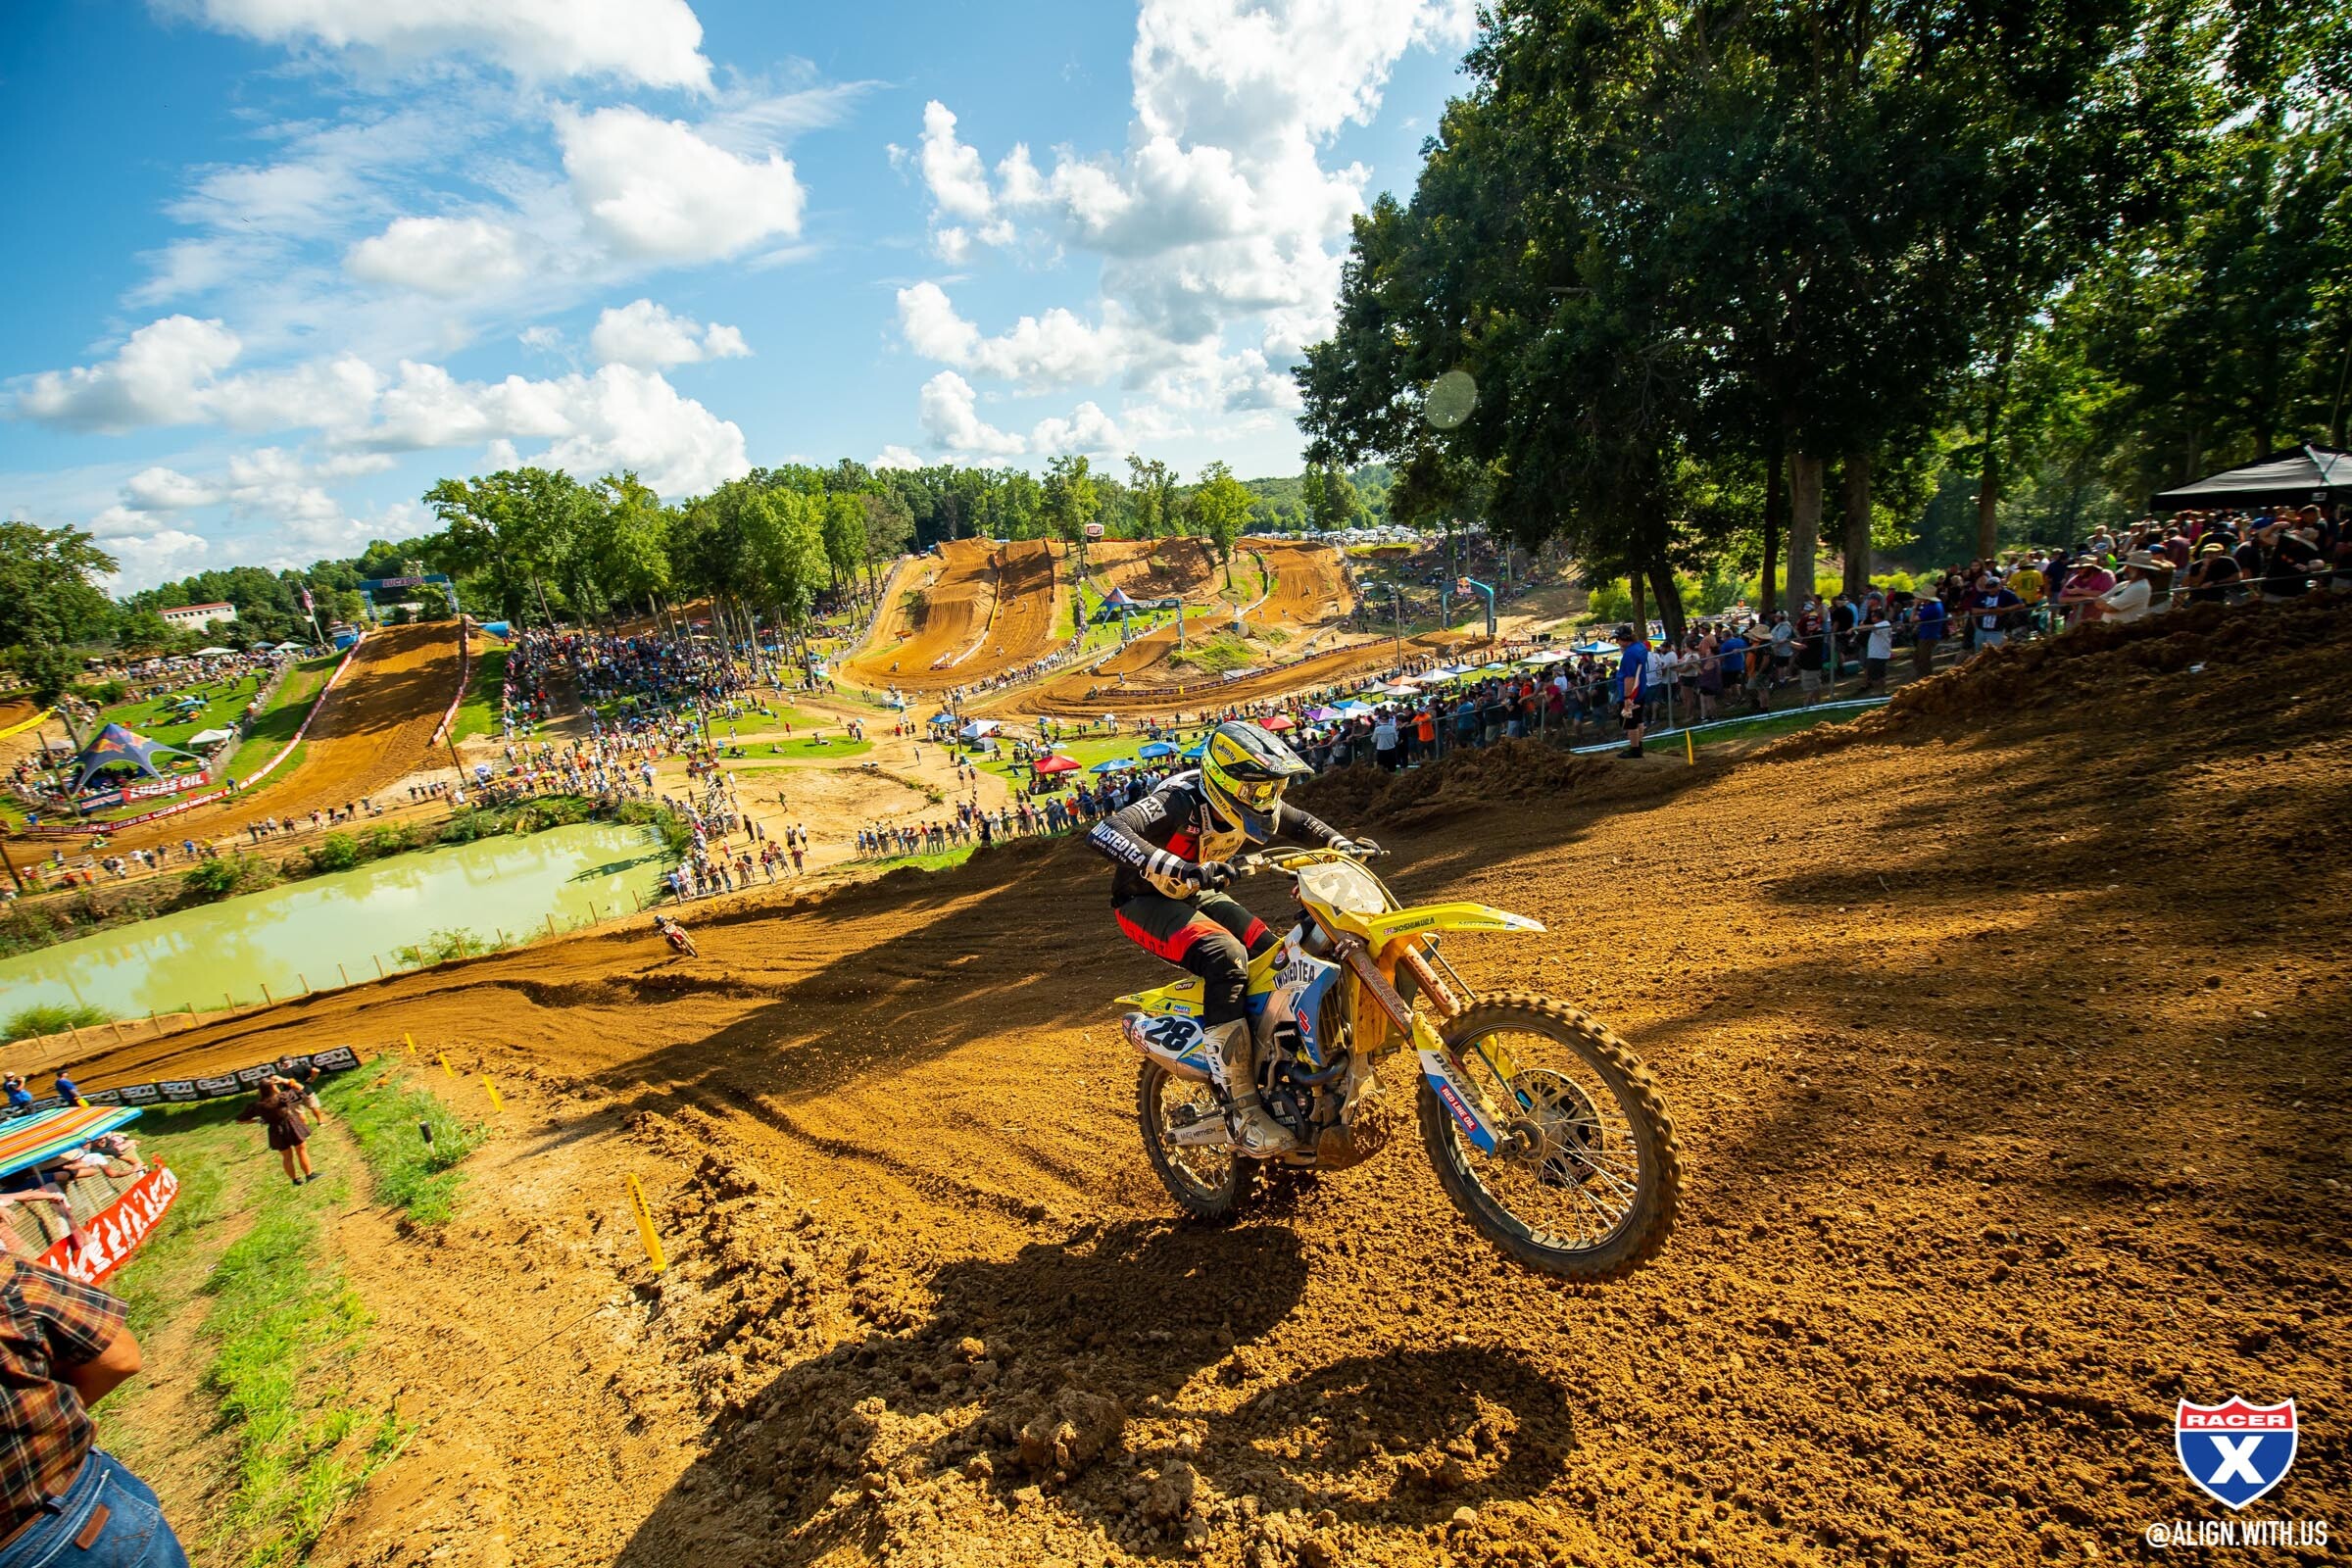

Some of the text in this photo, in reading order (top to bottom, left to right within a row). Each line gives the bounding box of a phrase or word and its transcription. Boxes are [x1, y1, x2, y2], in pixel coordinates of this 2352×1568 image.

[383, 576, 424, 588] LUCAS OIL
[129, 773, 205, 799] LUCAS OIL
[1141, 798, 1163, 818] MX
[1126, 842, 1147, 868] TEA
[1394, 916, 1436, 933] YOSHIMURA
[1273, 959, 1315, 991] TWISTED TEA
[1145, 1016, 1198, 1052] 28
[313, 1047, 353, 1067] GEICO
[238, 1063, 276, 1083] GEICO
[121, 1084, 157, 1100] GEICO
[160, 1081, 194, 1095] GEICO
[197, 1075, 236, 1092] GEICO
[1442, 1088, 1476, 1129] RED LINE OIL
